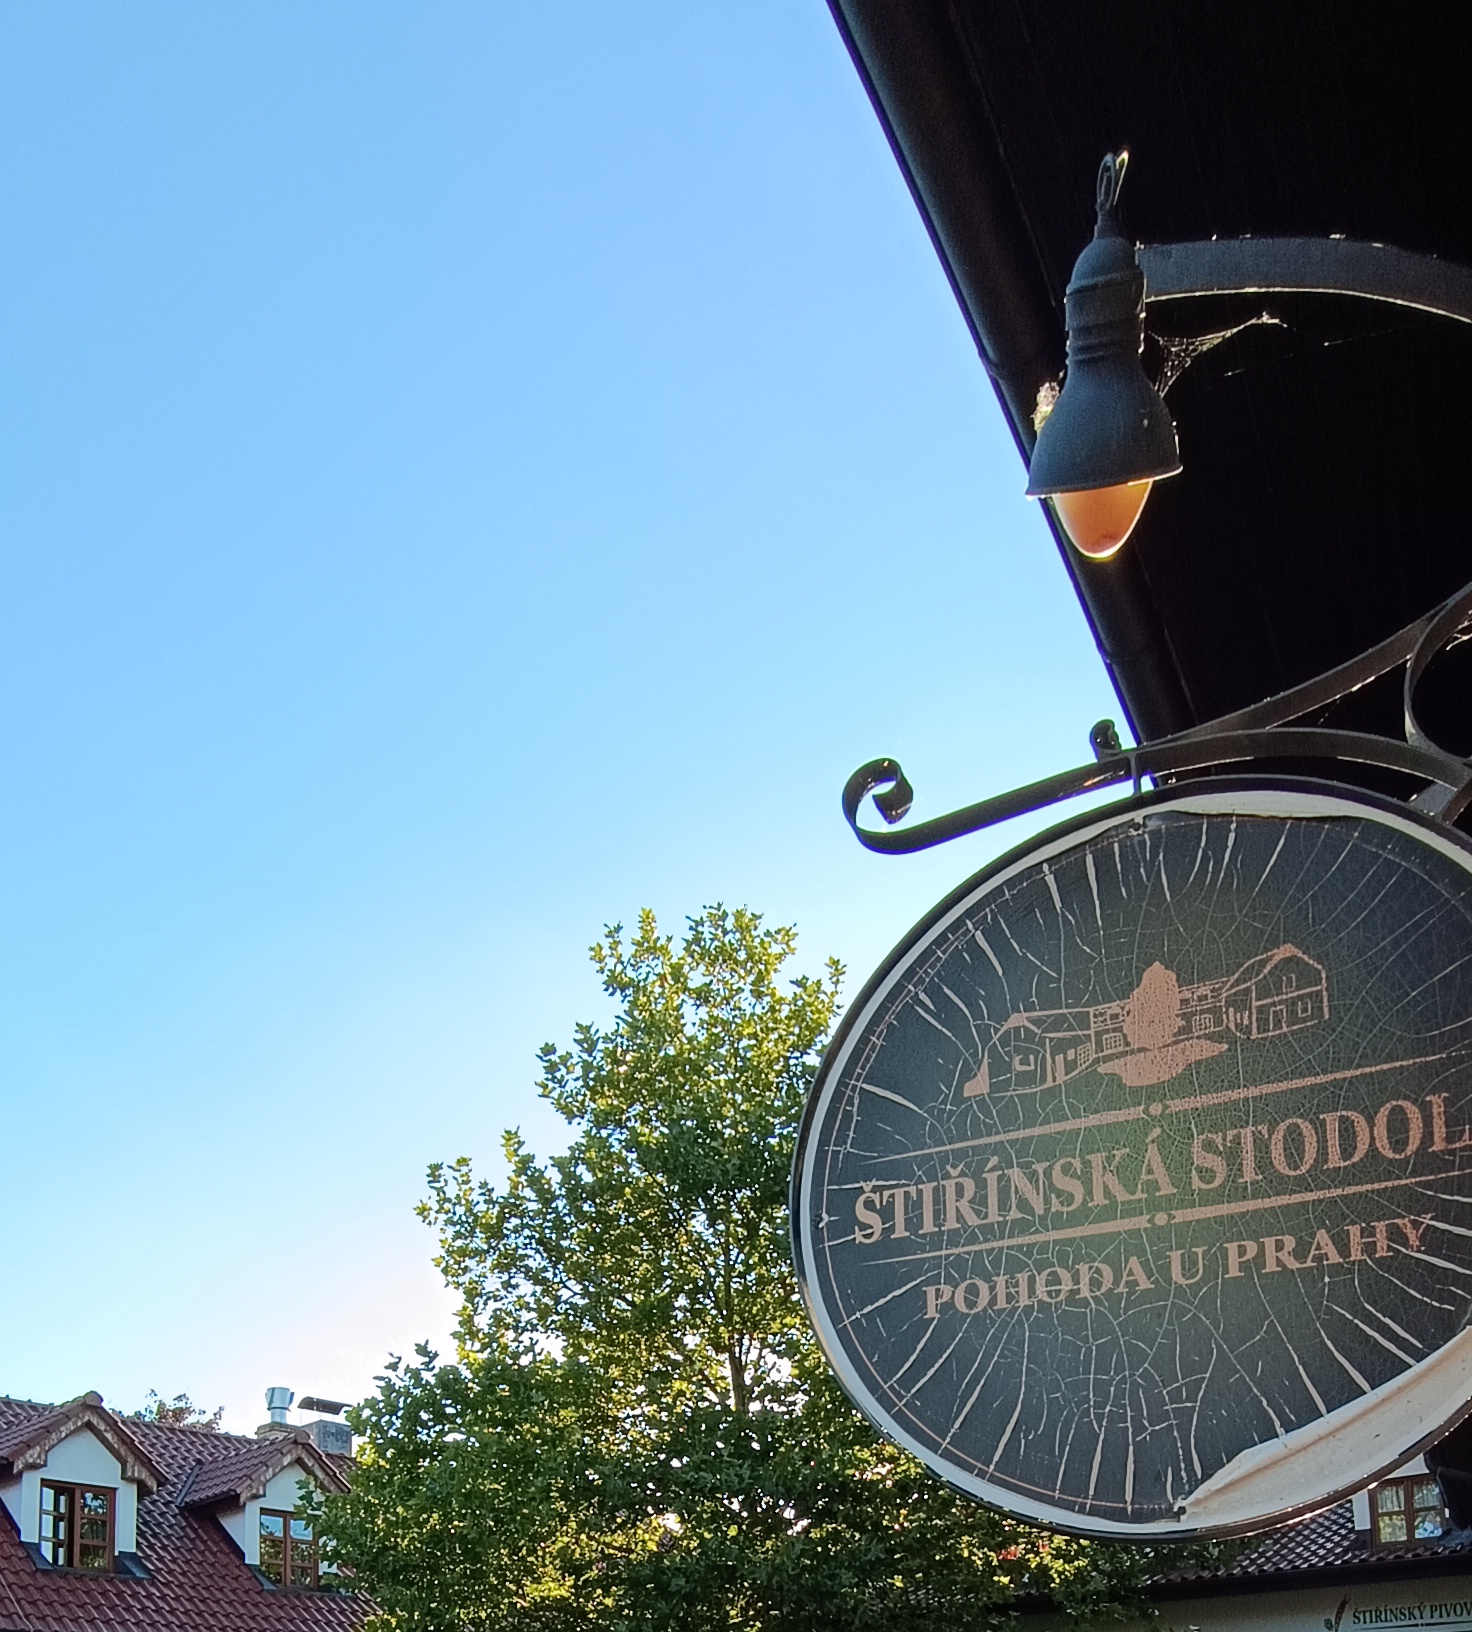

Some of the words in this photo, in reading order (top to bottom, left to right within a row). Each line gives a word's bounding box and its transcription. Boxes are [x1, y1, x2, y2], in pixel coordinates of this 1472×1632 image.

[854, 1127, 1177, 1244] ŠTIŘÍNSKÁ
[1192, 1093, 1472, 1190] STODOL
[922, 1256, 1153, 1318] POHODA
[1166, 1247, 1208, 1285] U
[1223, 1214, 1436, 1278] PRAHY
[1352, 1602, 1426, 1625] ŠTIŘÍNSKÝ
